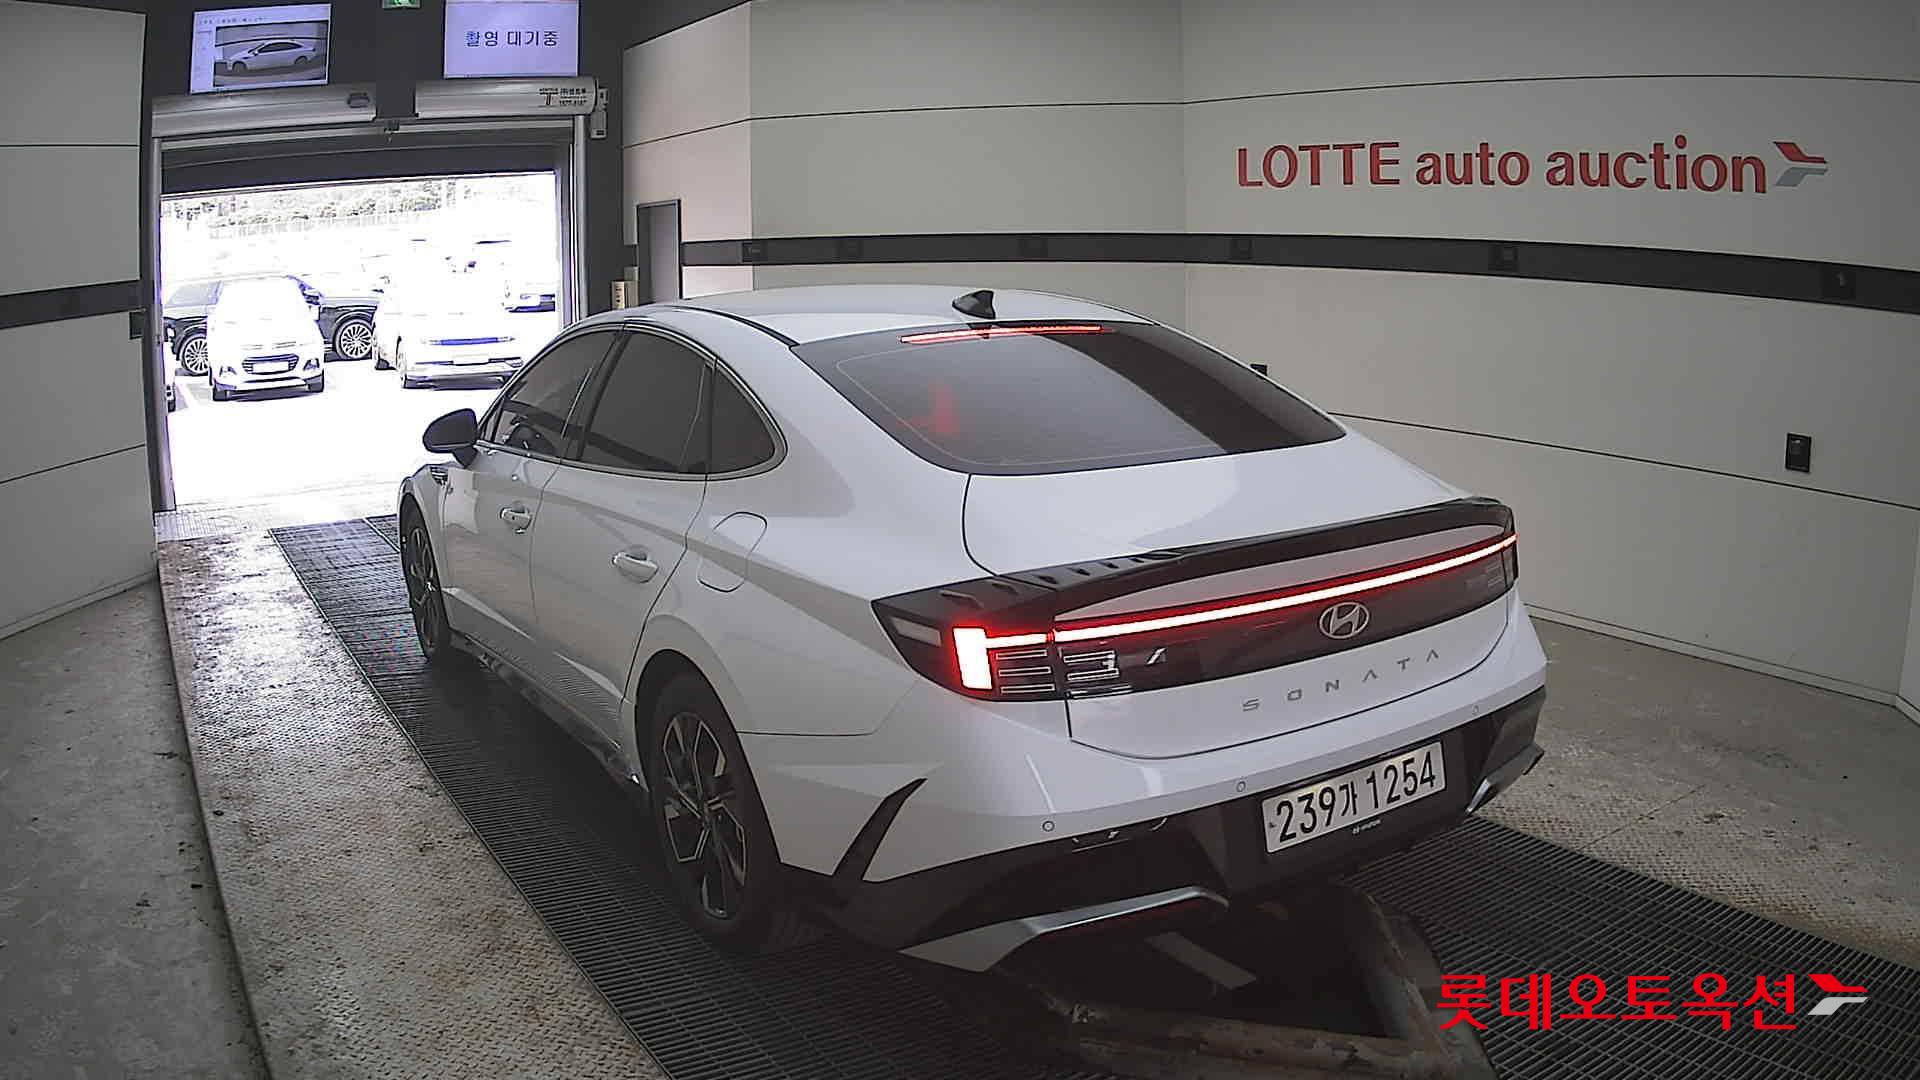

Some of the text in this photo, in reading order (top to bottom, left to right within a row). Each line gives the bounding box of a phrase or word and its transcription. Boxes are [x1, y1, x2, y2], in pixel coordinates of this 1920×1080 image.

[507, 30, 558, 47] 대기중
[1236, 134, 1767, 194] LOTTE auto auction
[1242, 649, 1440, 712] SONATA
[1276, 751, 1436, 843] 239가 1254
